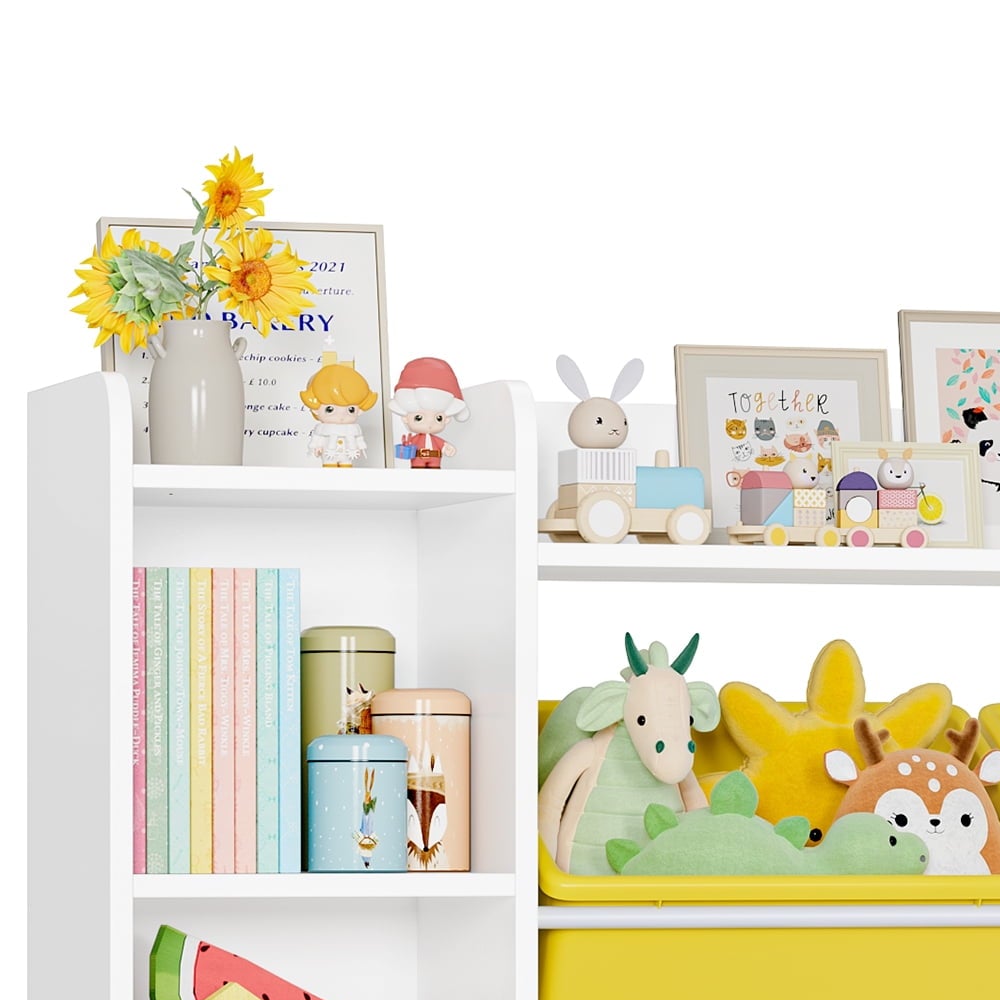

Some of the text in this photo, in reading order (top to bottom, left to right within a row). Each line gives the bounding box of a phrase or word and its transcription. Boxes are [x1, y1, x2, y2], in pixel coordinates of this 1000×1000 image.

[309, 261, 345, 273] 2021
[268, 354, 307, 363] cookies
[267, 403, 291, 411] cake
[257, 428, 299, 438] cupcake
